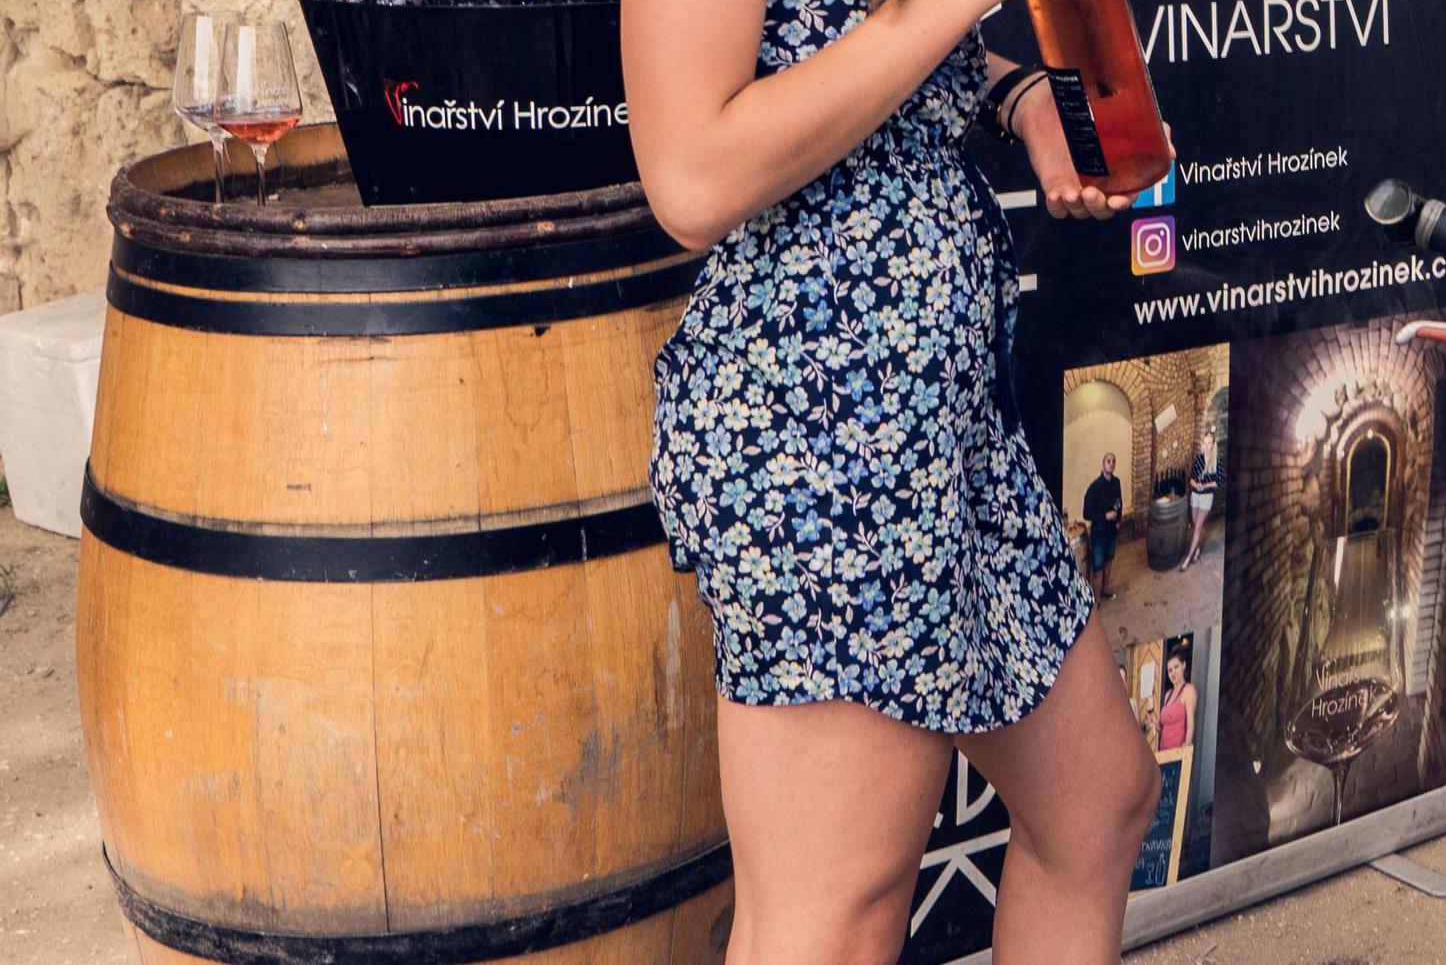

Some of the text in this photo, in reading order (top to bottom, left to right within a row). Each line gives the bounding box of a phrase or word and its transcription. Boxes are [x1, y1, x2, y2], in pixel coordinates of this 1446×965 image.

[513, 96, 629, 130] Hrozíne
[1180, 145, 1348, 185] Vinařství Hrozínek
[1181, 210, 1340, 252] vinarstvihrozinek
